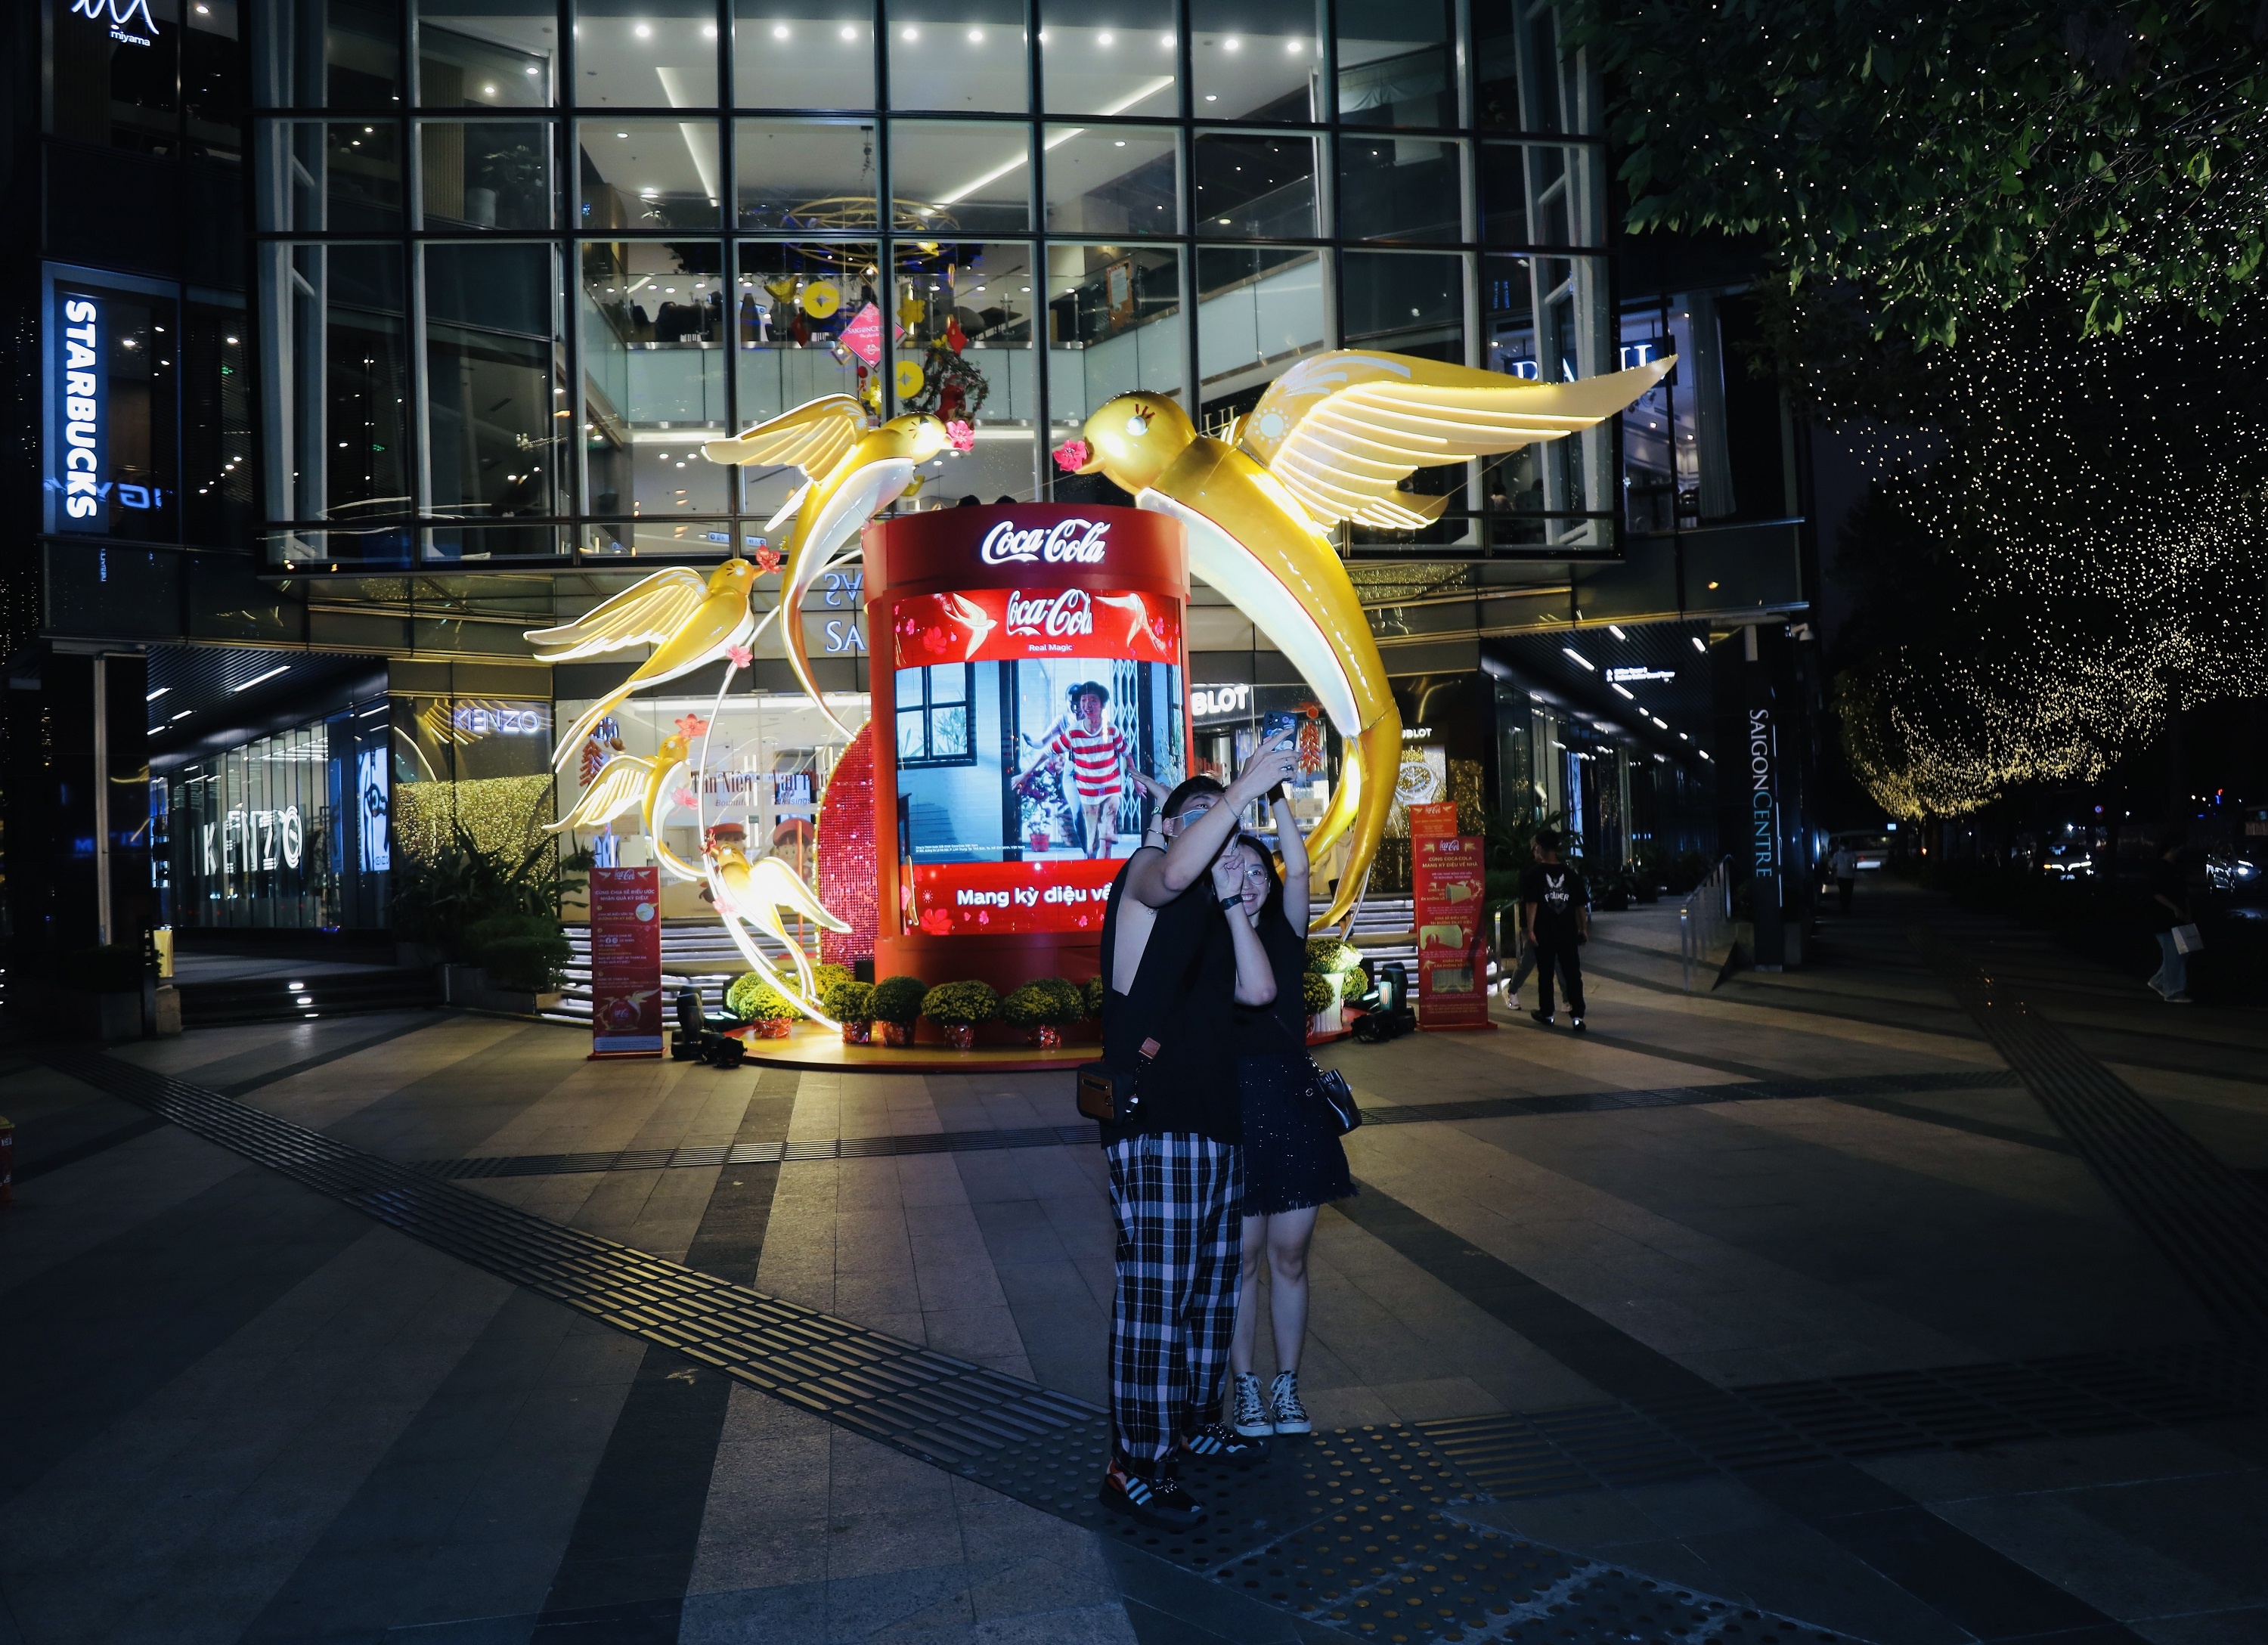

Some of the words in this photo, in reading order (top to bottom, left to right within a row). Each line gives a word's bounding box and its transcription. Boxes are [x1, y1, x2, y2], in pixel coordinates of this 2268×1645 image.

[110, 31, 150, 46] miyama
[66, 299, 98, 519] STARBUCKS
[981, 518, 1111, 565] Coca-Cola
[1006, 588, 1093, 637] Coca-Cola
[1028, 643, 1048, 652] Real
[1048, 643, 1074, 652] Magic
[454, 708, 541, 733] KENZO
[203, 805, 302, 875] KENZO
[957, 889, 1010, 907] Mang
[1014, 886, 1040, 906] kỳ
[1043, 884, 1087, 906] diệu
